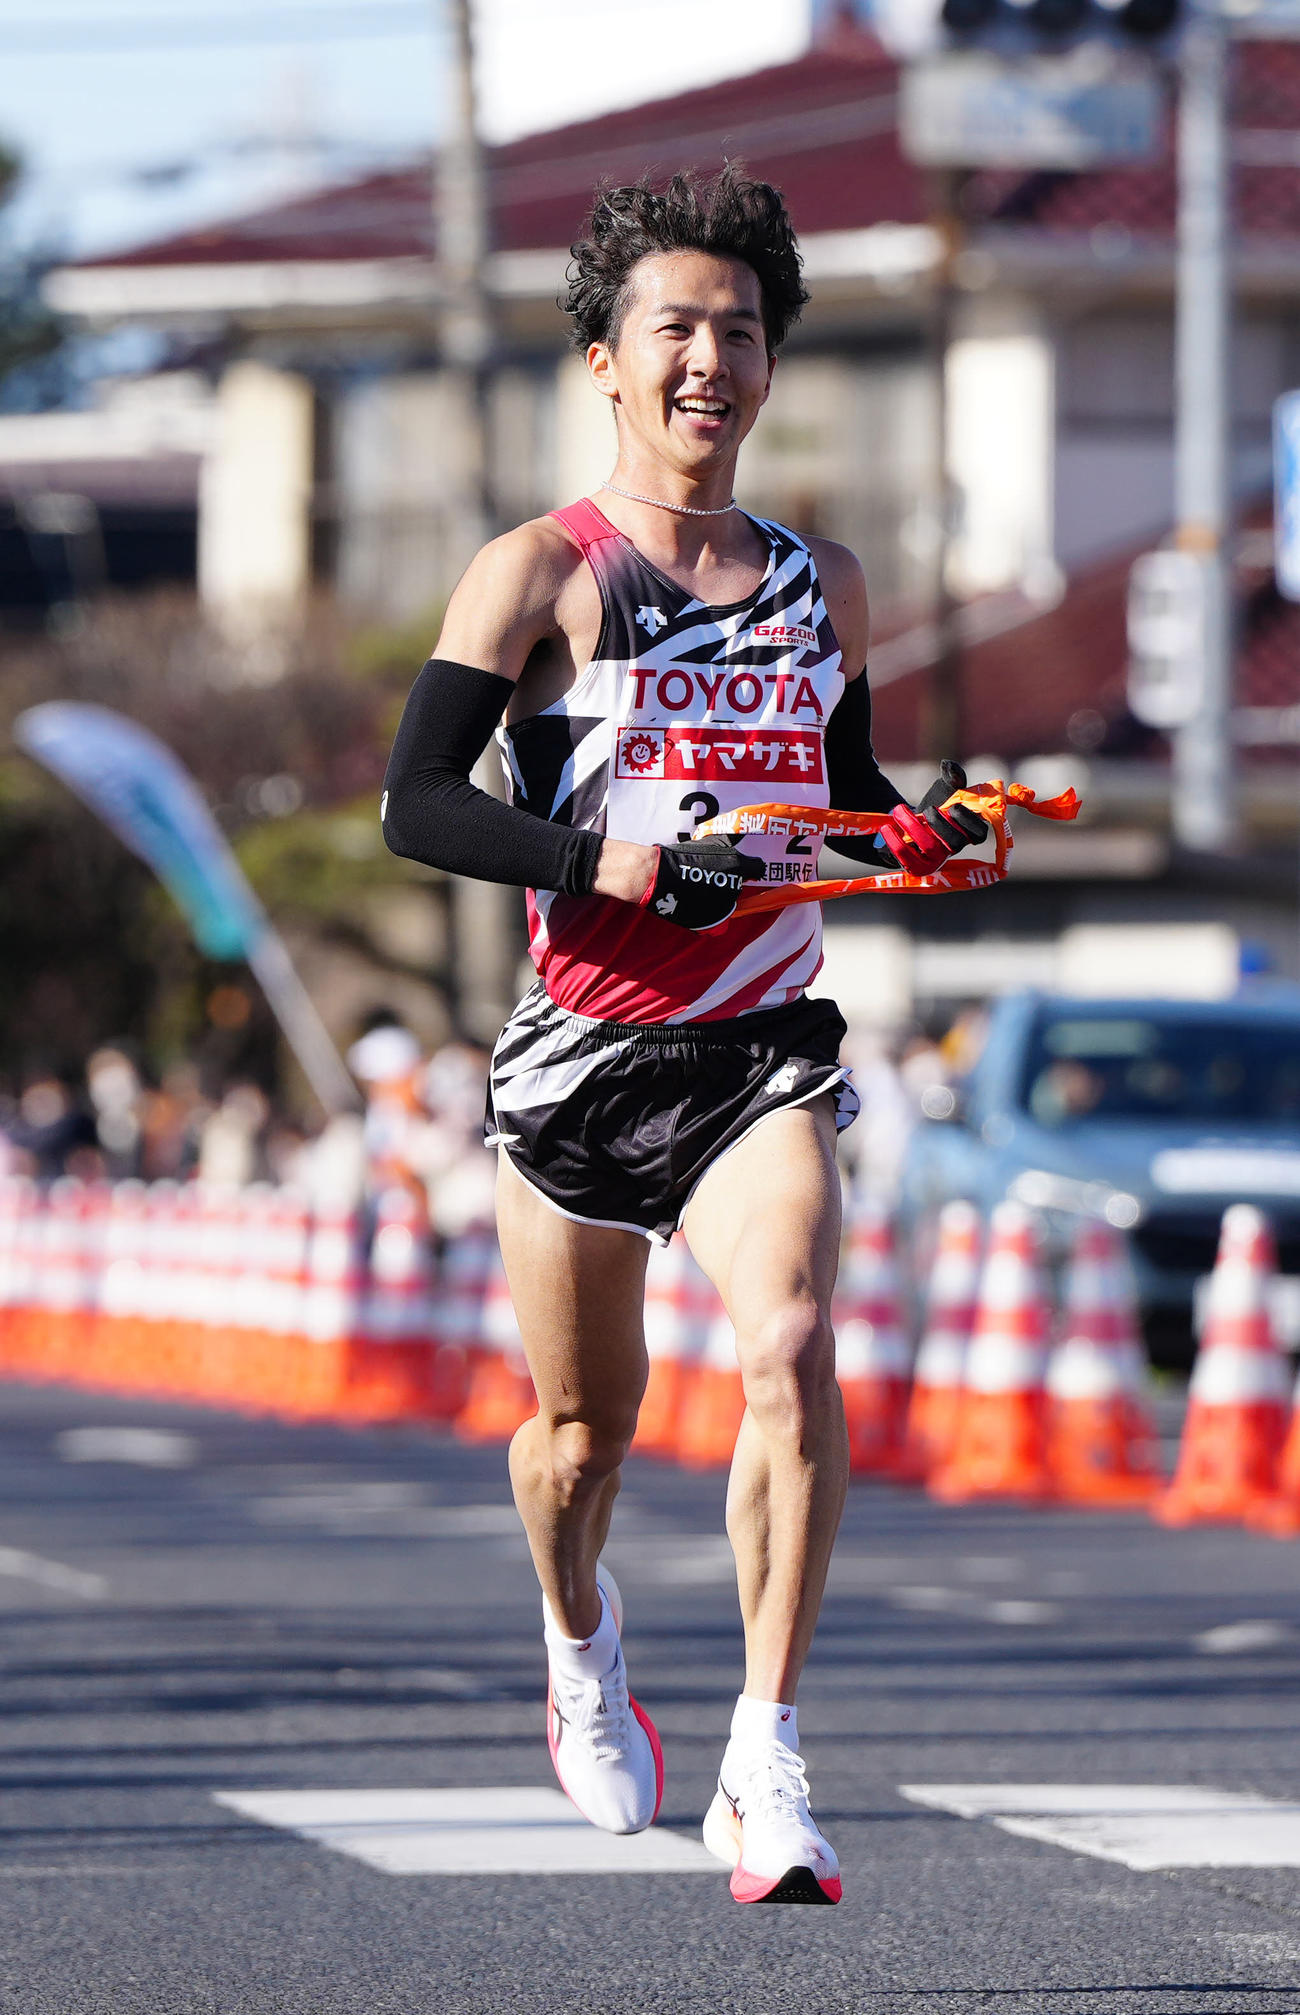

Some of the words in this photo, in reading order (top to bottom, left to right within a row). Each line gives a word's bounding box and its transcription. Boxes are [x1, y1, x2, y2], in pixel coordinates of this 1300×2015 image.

[754, 625, 816, 642] GAZOO
[769, 637, 809, 647] SPORTS
[629, 668, 823, 717] TOYOTA
[675, 739, 815, 772] ヤマザキ
[679, 864, 743, 890] TOYOTA
